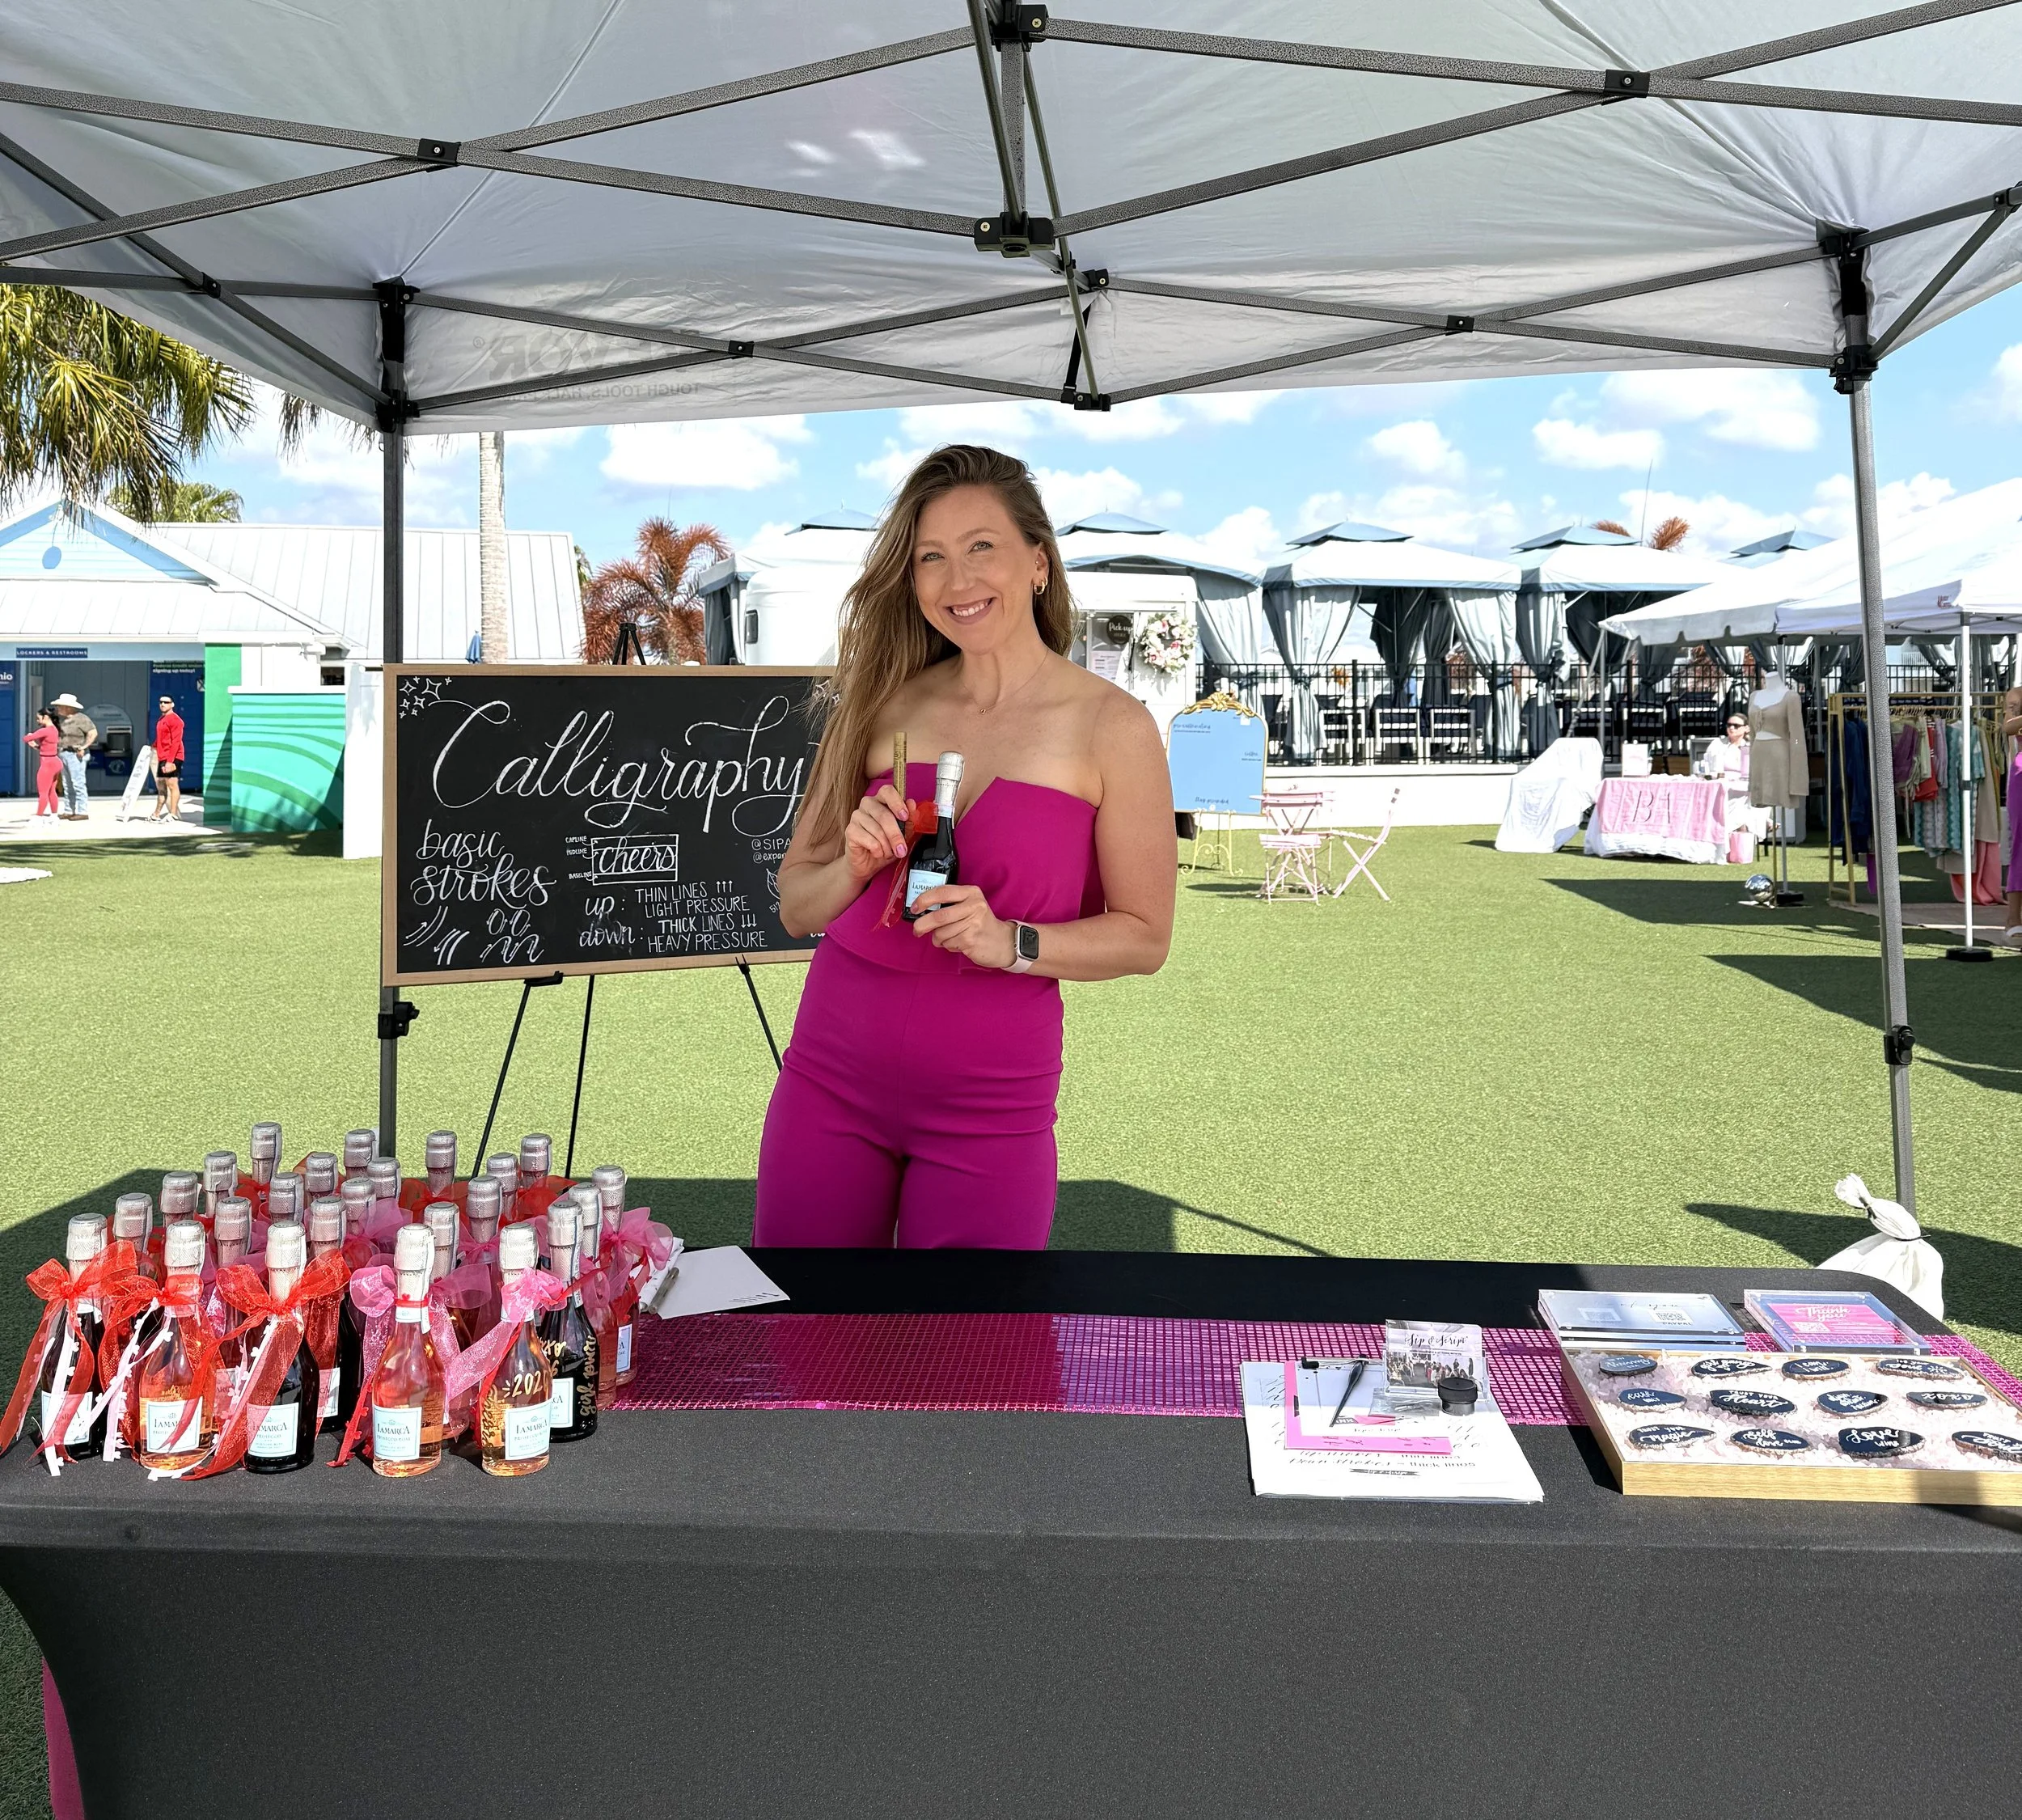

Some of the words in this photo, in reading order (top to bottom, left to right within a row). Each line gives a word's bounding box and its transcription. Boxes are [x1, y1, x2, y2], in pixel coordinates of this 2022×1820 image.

[1109, 621, 1122, 632] Pick
[429, 696, 809, 837] Calligraphy
[416, 819, 506, 869] basic
[599, 836, 677, 874] cheers
[409, 853, 558, 910] strokes
[634, 887, 667, 904] THIN
[671, 880, 708, 901] LINES
[645, 899, 682, 919] LIGHT
[687, 894, 751, 915] PRESSURE
[658, 915, 699, 934] THICK
[701, 912, 734, 933] LINES
[647, 933, 691, 954] HEAVY
[695, 930, 768, 951] PRESSURE
[1795, 1305, 1851, 1317] Thank
[1817, 1312, 1848, 1323] you
[1404, 1333, 1425, 1348] Sip
[577, 1384, 598, 1417] girl
[1719, 1394, 1788, 1408] Heart
[377, 1423, 411, 1436] LAMARCA
[1846, 1428, 1900, 1444] Love
